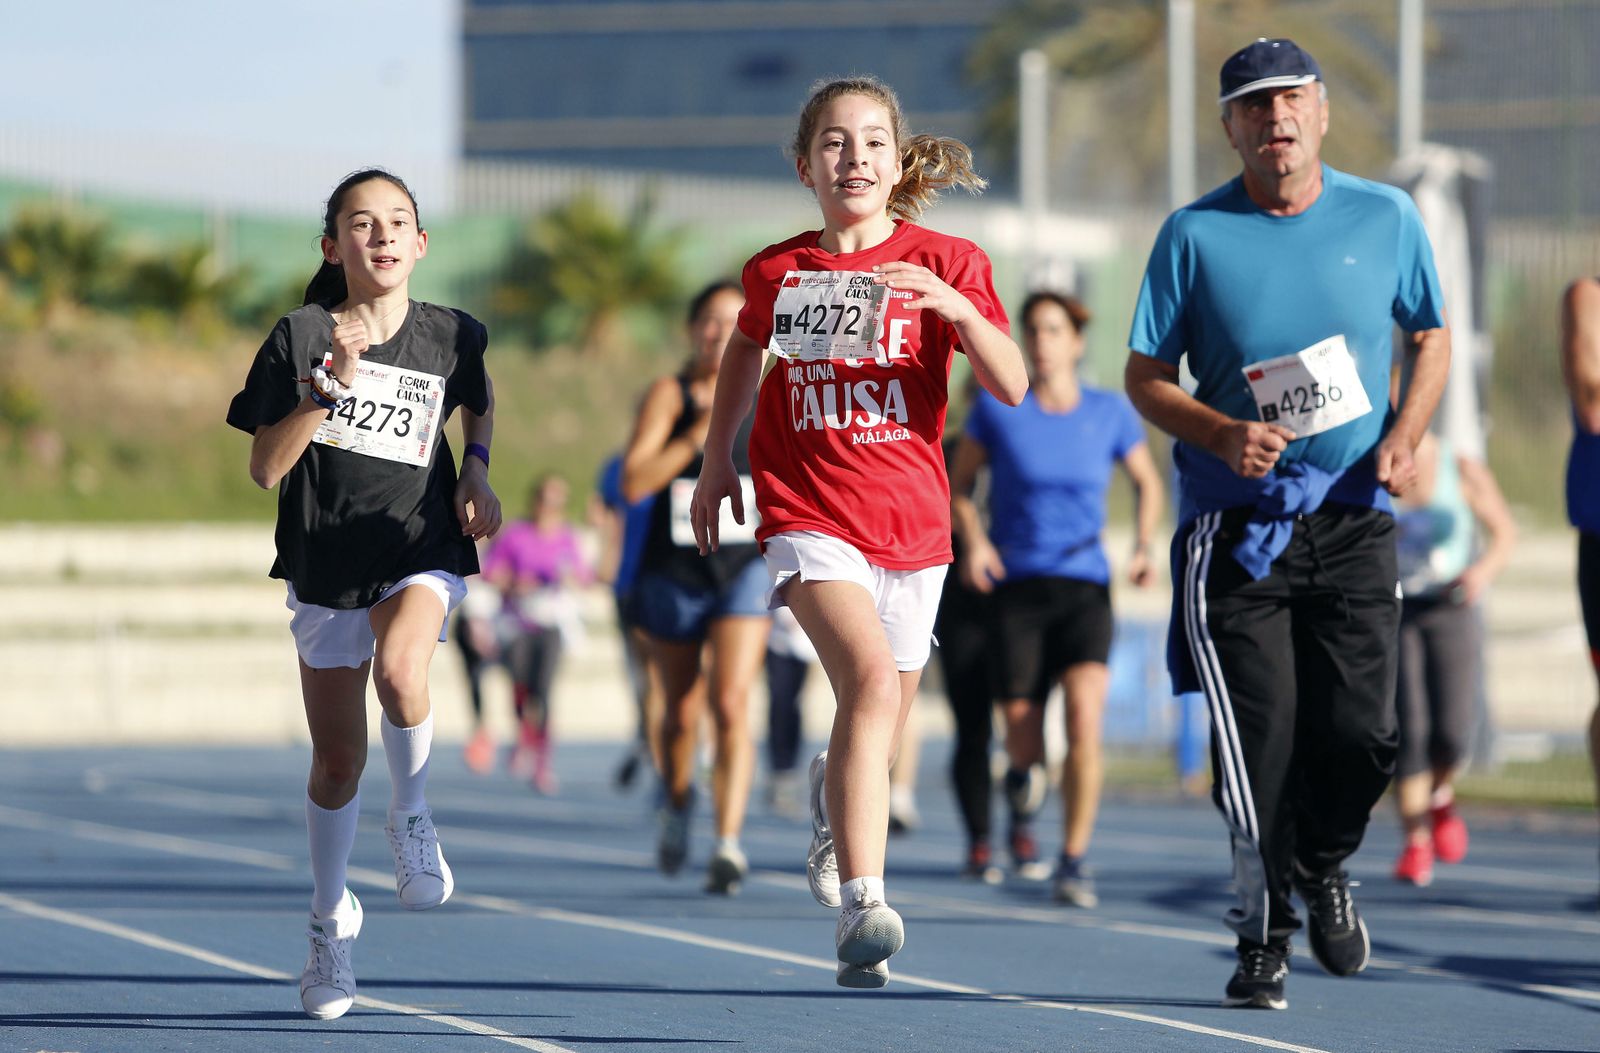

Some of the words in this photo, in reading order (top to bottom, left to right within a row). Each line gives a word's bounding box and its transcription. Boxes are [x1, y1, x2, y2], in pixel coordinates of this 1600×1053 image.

[849, 276, 874, 287] CORR
[794, 304, 862, 335] 4272
[807, 363, 836, 382] UNA
[399, 374, 432, 391] CORRE
[396, 388, 427, 405] CAUSA
[790, 378, 909, 432] CAUSA
[1280, 377, 1342, 416] 4256
[337, 396, 413, 437] 4273
[852, 428, 912, 445] MÁLAGA
